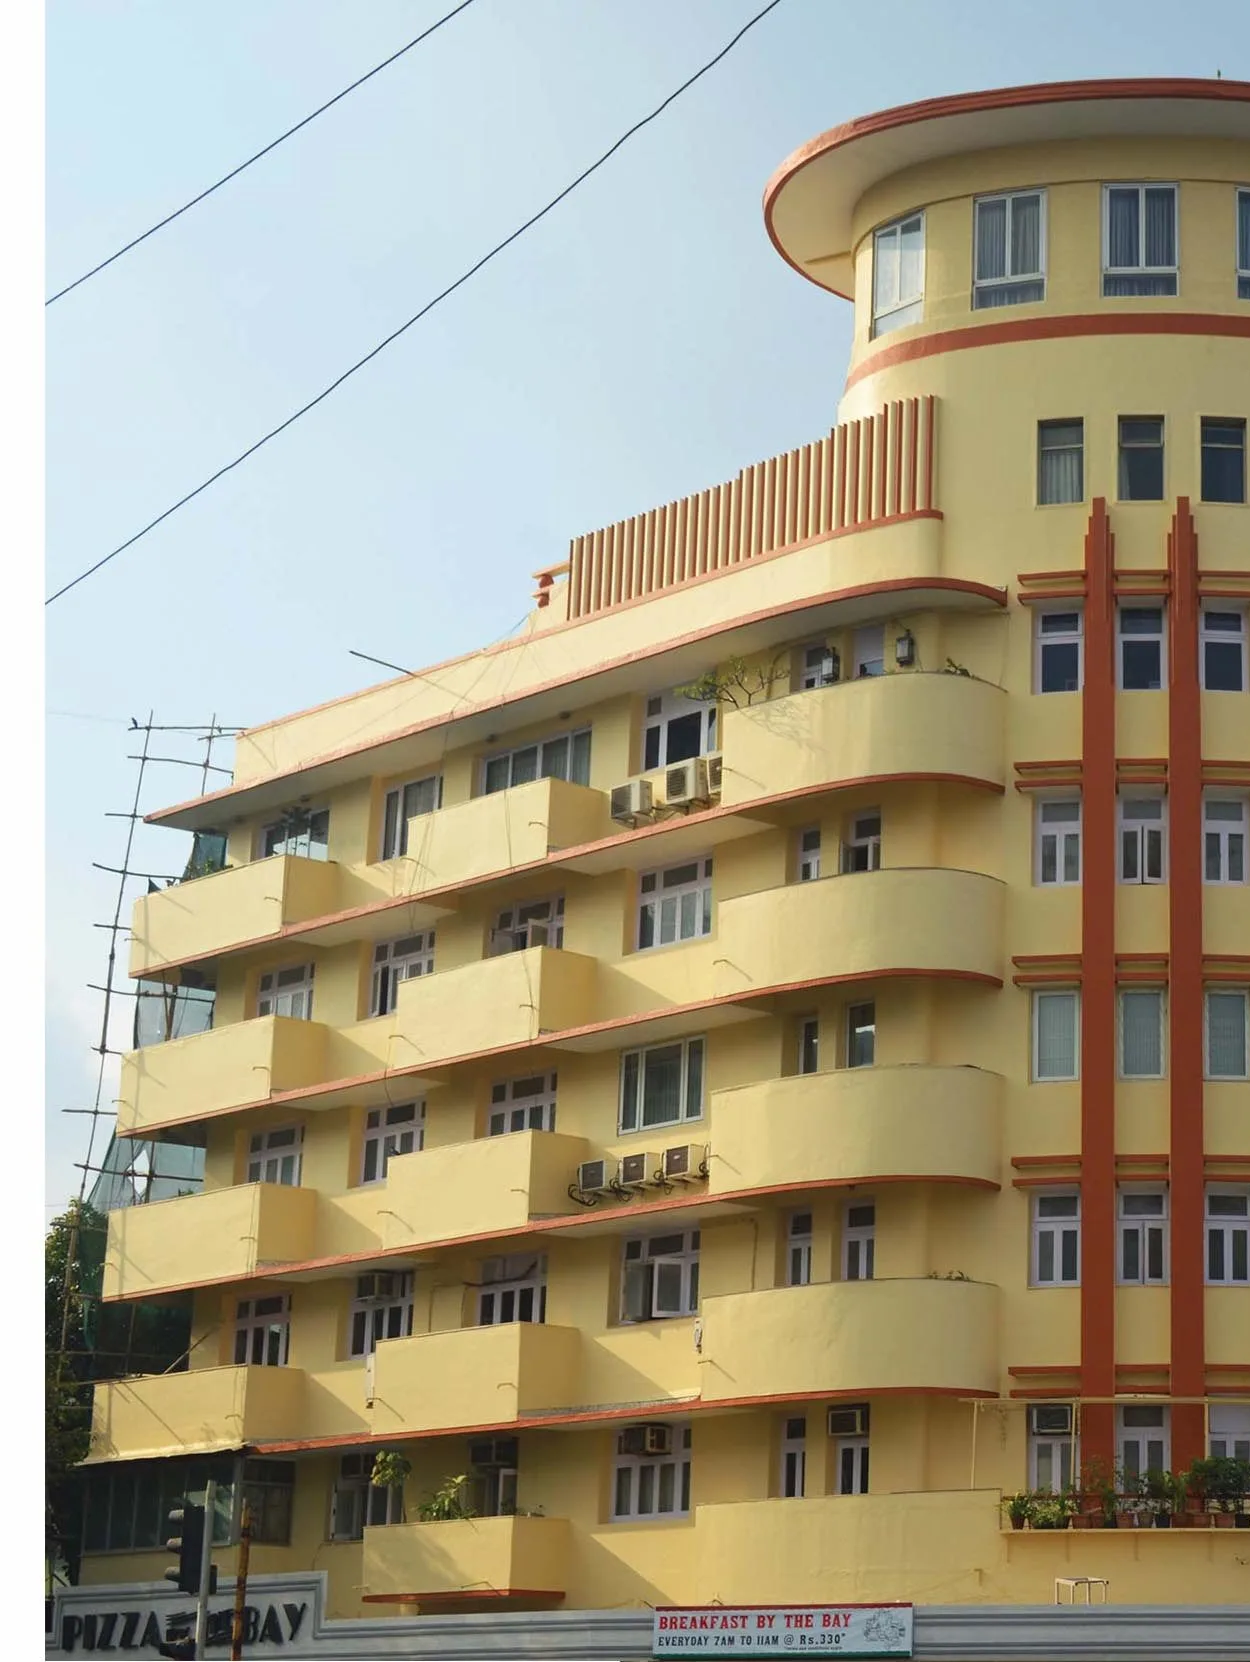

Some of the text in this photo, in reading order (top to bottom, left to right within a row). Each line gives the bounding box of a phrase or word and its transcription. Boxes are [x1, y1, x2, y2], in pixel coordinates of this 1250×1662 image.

[63, 1611, 161, 1650] PIZZA
[242, 1603, 306, 1646] BAY
[659, 1613, 852, 1630] BREAKFAST BY THE BAY
[658, 1636, 709, 1646] EVERYDAY
[714, 1635, 735, 1646] 7AM
[740, 1635, 752, 1645] TO
[757, 1635, 779, 1645] 11AM
[784, 1634, 794, 1645] @
